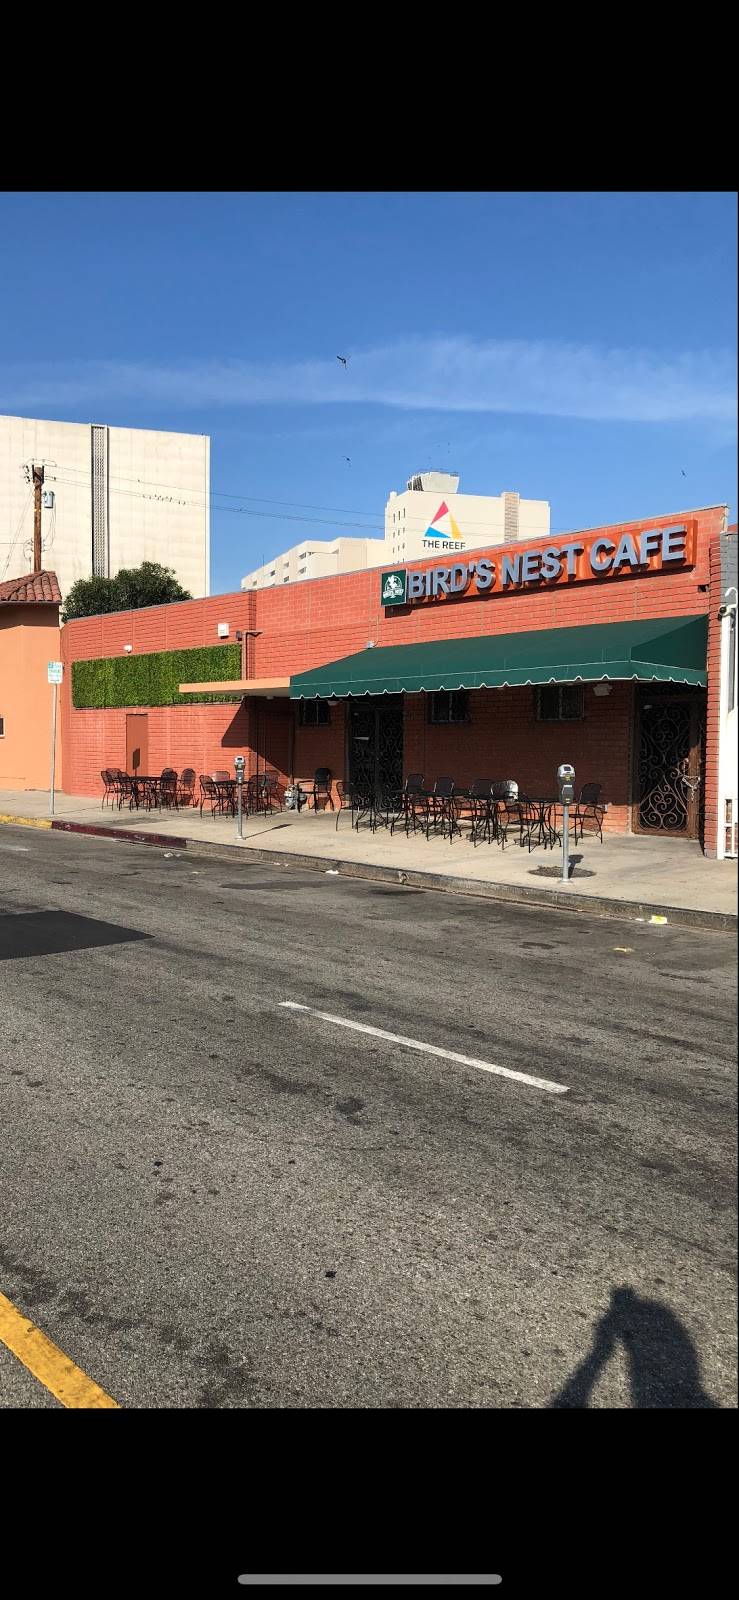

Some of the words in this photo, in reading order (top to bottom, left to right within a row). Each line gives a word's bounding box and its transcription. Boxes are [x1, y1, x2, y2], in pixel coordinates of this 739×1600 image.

[408, 558, 495, 599] BIRD'S
[501, 541, 584, 585] NEST
[590, 524, 687, 571] CAFE
[422, 539, 440, 549] THE
[442, 540, 466, 550] REEF
